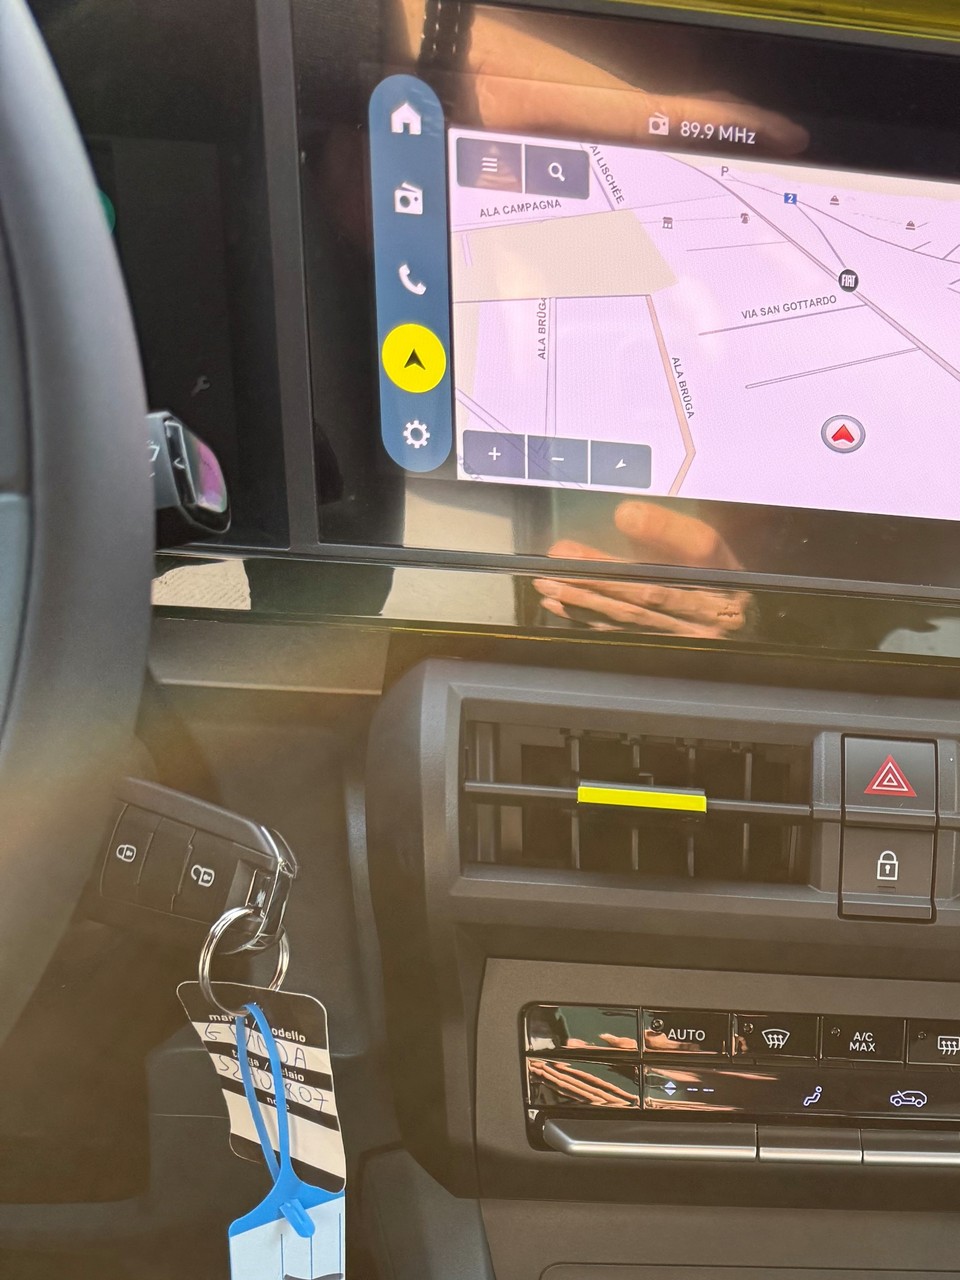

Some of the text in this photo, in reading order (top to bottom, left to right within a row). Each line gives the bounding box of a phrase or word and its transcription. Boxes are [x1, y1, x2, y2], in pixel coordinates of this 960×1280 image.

[680, 121, 756, 145] 89.9 MHz
[787, 193, 795, 204] 2
[479, 199, 562, 218] ALA CAMPAGNA
[841, 274, 857, 288] FIAT
[741, 295, 837, 320] VIA SAN GOTTARDO
[537, 337, 546, 360] ALA
[671, 356, 683, 379] ALA
[271, 1027, 306, 1043] odello
[667, 1028, 706, 1041] AUTO
[852, 1031, 874, 1043] A/C
[849, 1041, 876, 1053] MAX
